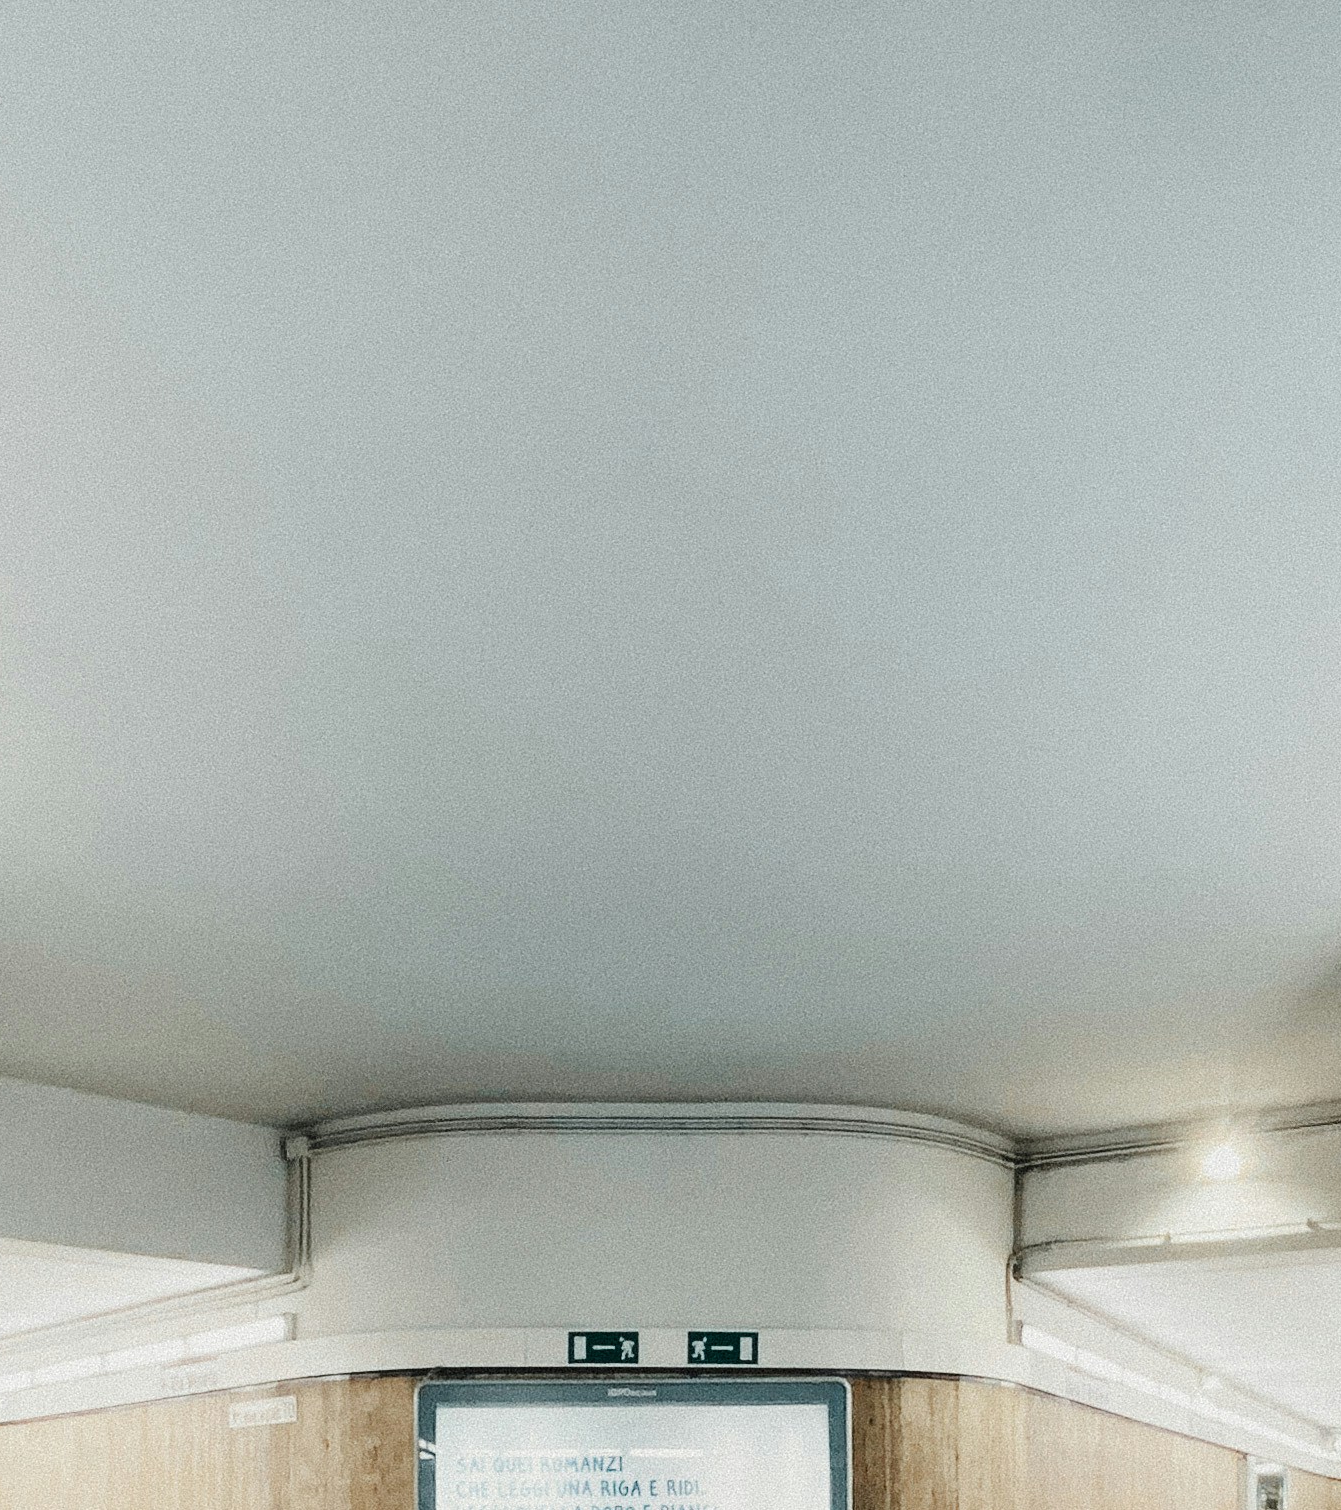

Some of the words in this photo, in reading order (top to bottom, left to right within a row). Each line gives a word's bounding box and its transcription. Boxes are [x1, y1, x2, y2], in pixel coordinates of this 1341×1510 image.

[540, 1456, 625, 1474] ROMANZI
[558, 1480, 592, 1497] UNA
[600, 1479, 642, 1498] RIGA
[649, 1479, 658, 1496] E
